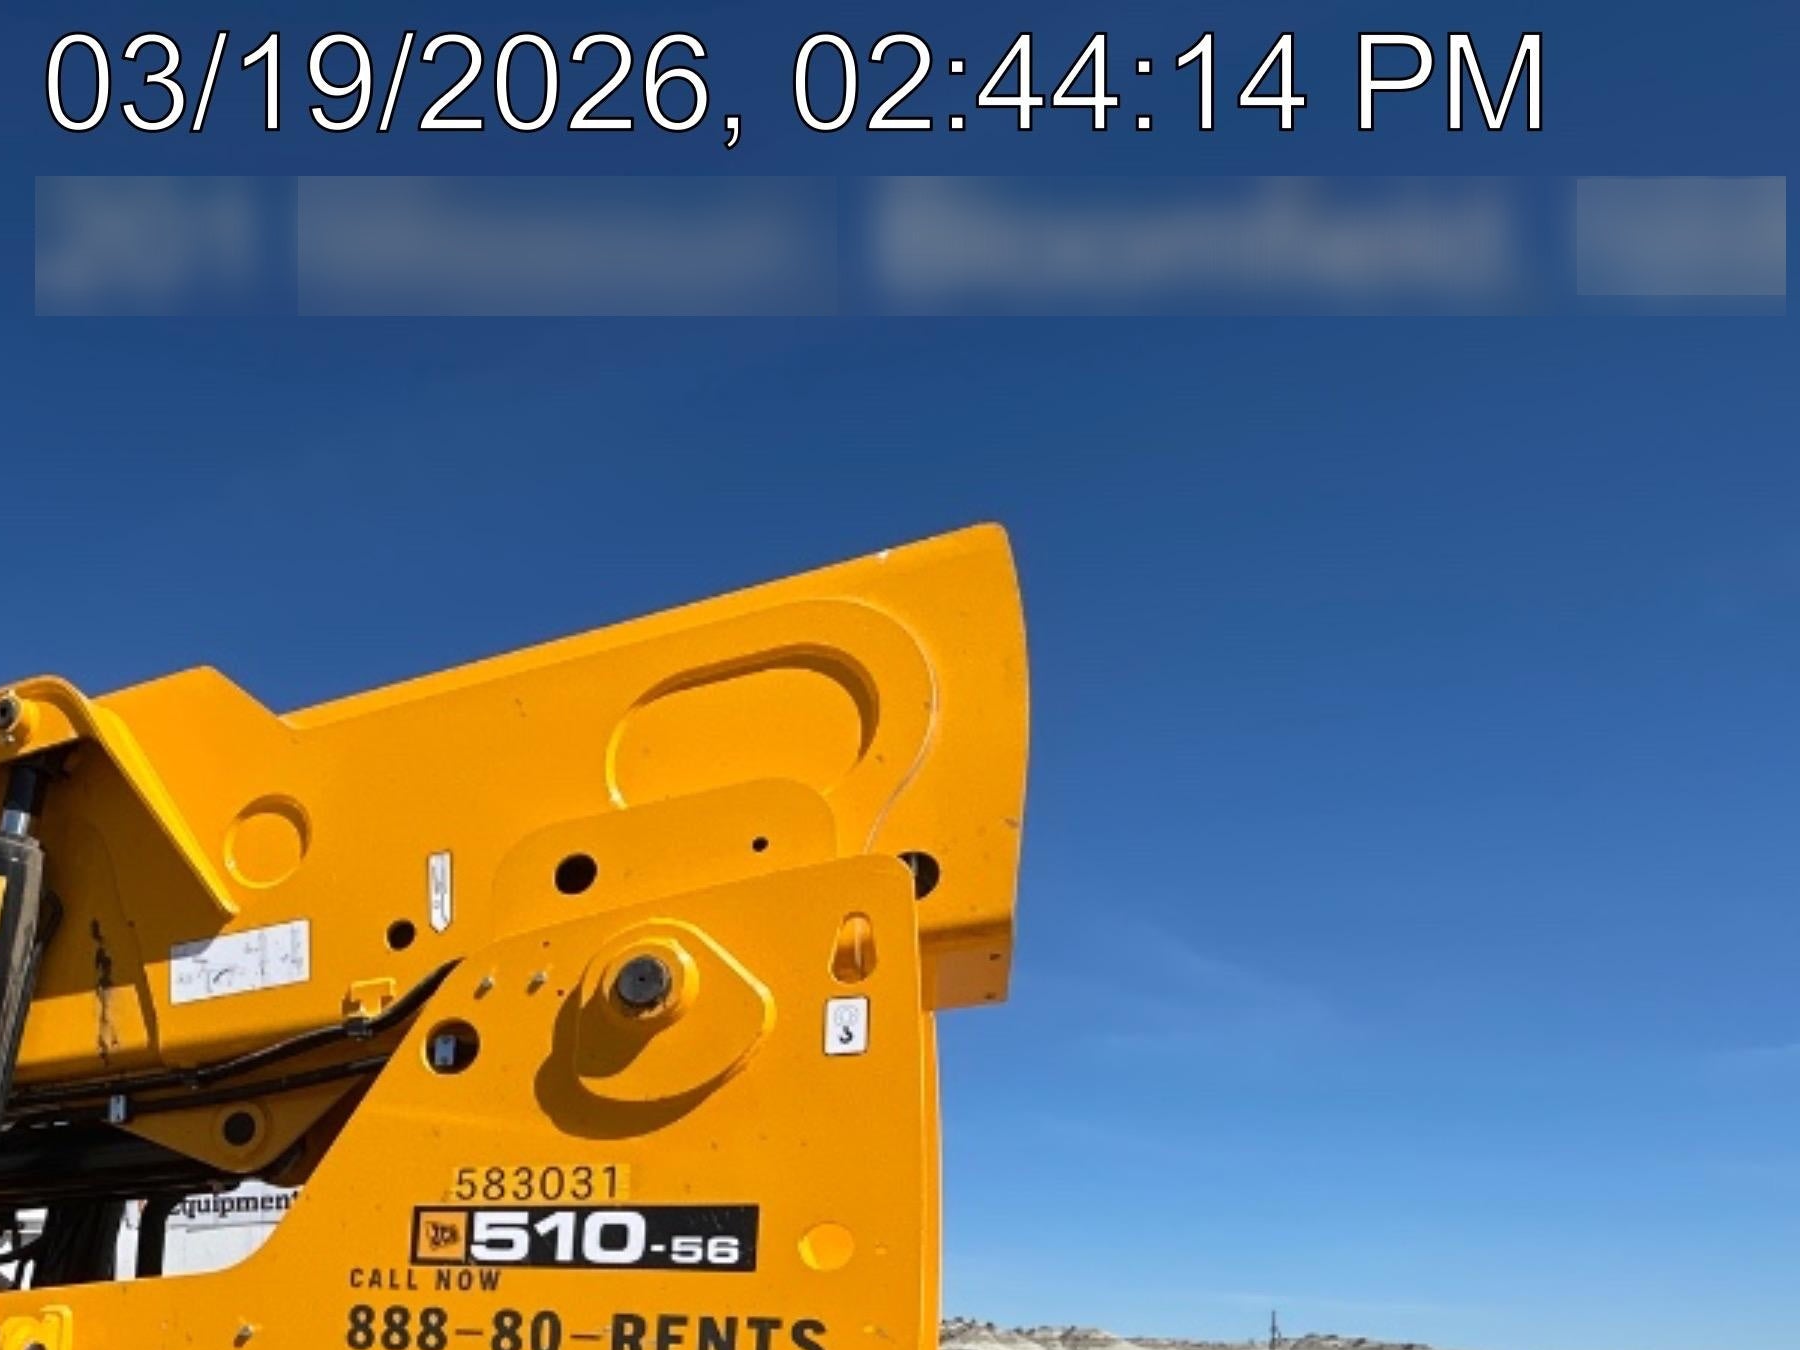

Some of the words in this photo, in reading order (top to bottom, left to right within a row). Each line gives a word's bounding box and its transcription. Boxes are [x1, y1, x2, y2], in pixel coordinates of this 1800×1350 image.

[456, 1166, 618, 1201] 583031
[470, 1211, 740, 1264] 510-56
[350, 1268, 418, 1291] CALL
[435, 1269, 502, 1293] NOW
